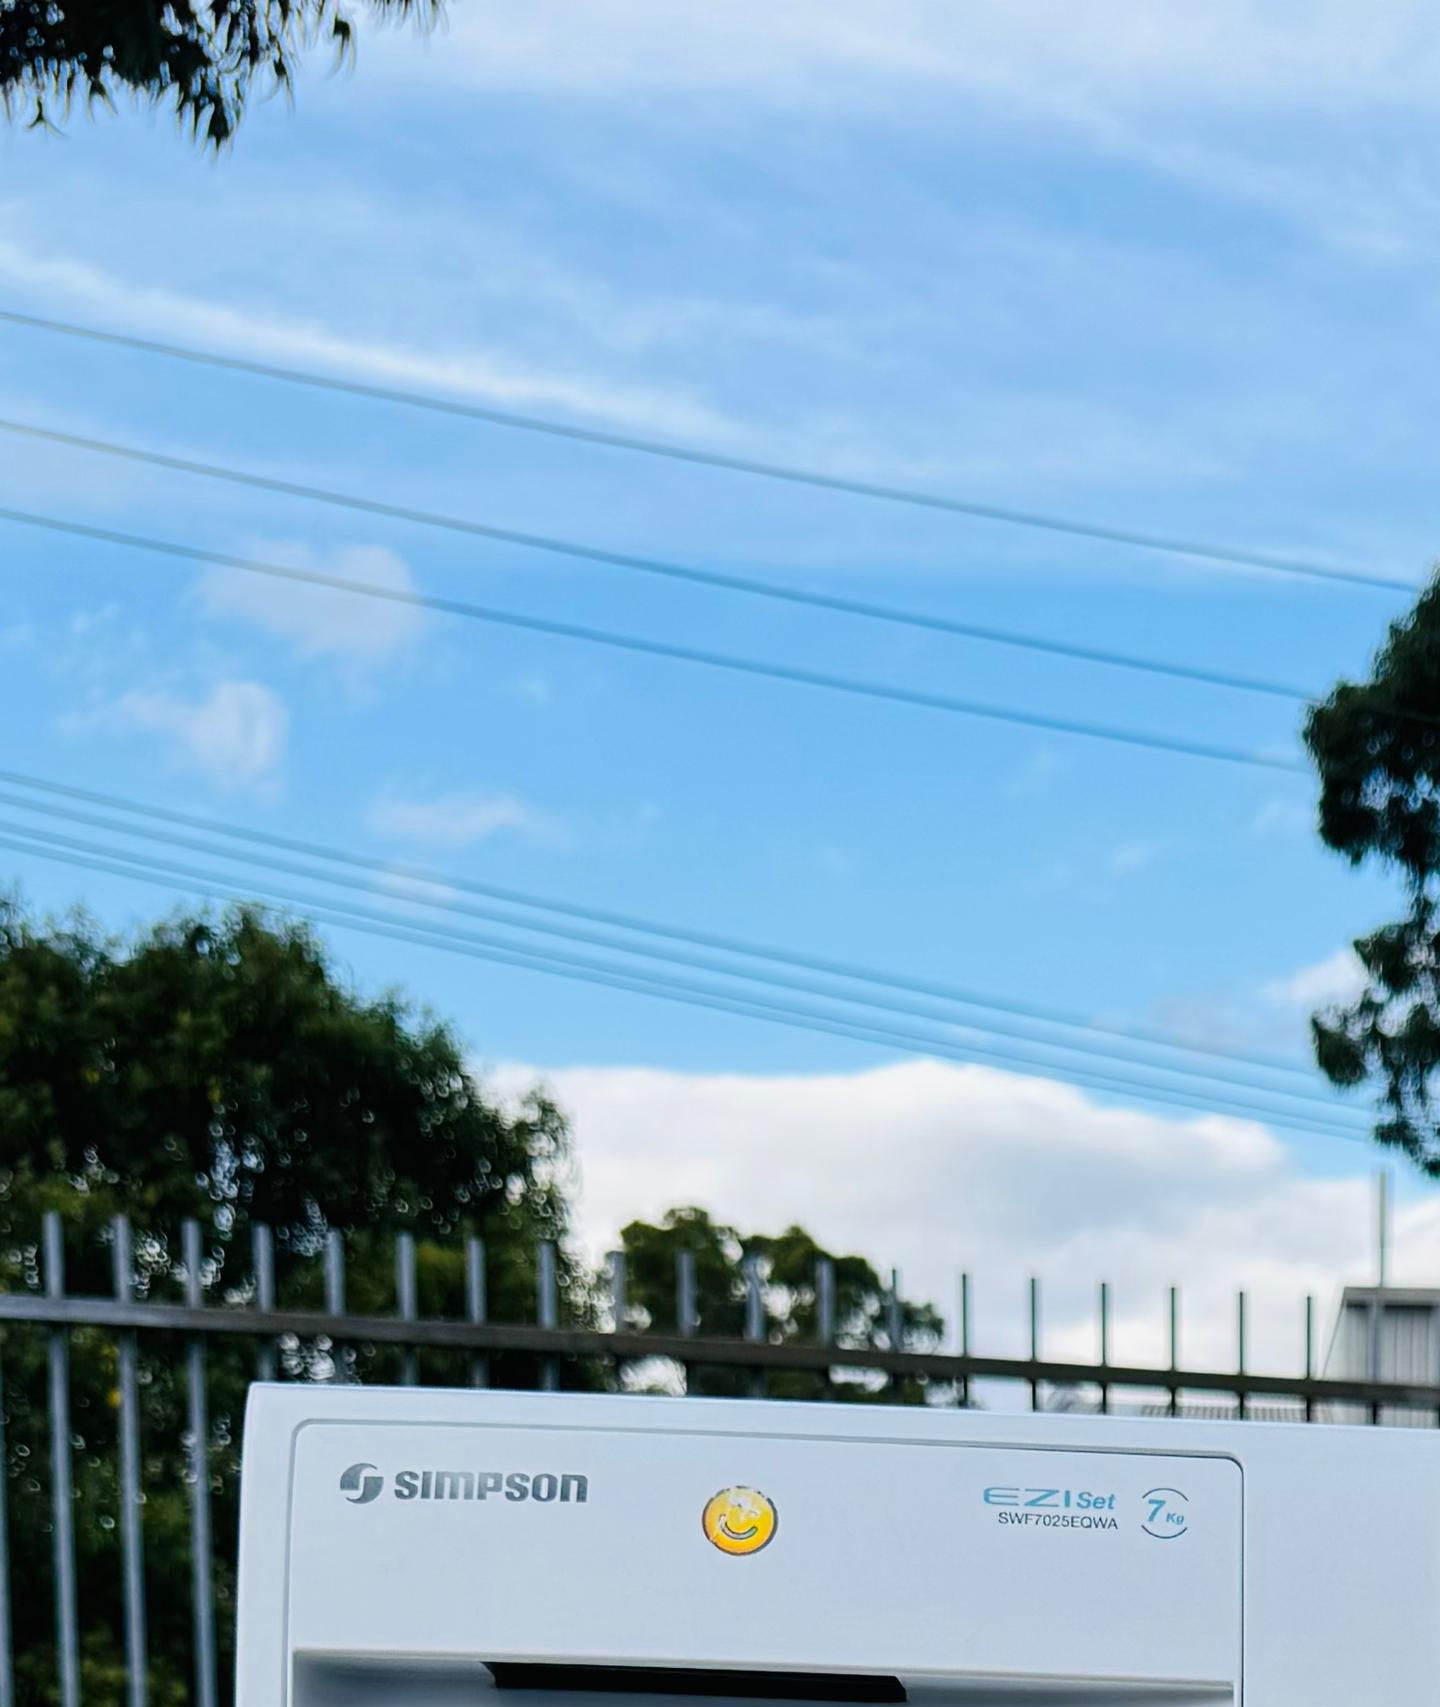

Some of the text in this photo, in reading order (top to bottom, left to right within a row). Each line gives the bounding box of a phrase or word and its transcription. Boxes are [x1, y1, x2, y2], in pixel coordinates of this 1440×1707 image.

[394, 1470, 588, 1503] SIMPSON
[998, 1512, 1118, 1530] SWF7025EQWA
[1147, 1499, 1166, 1523] 7
